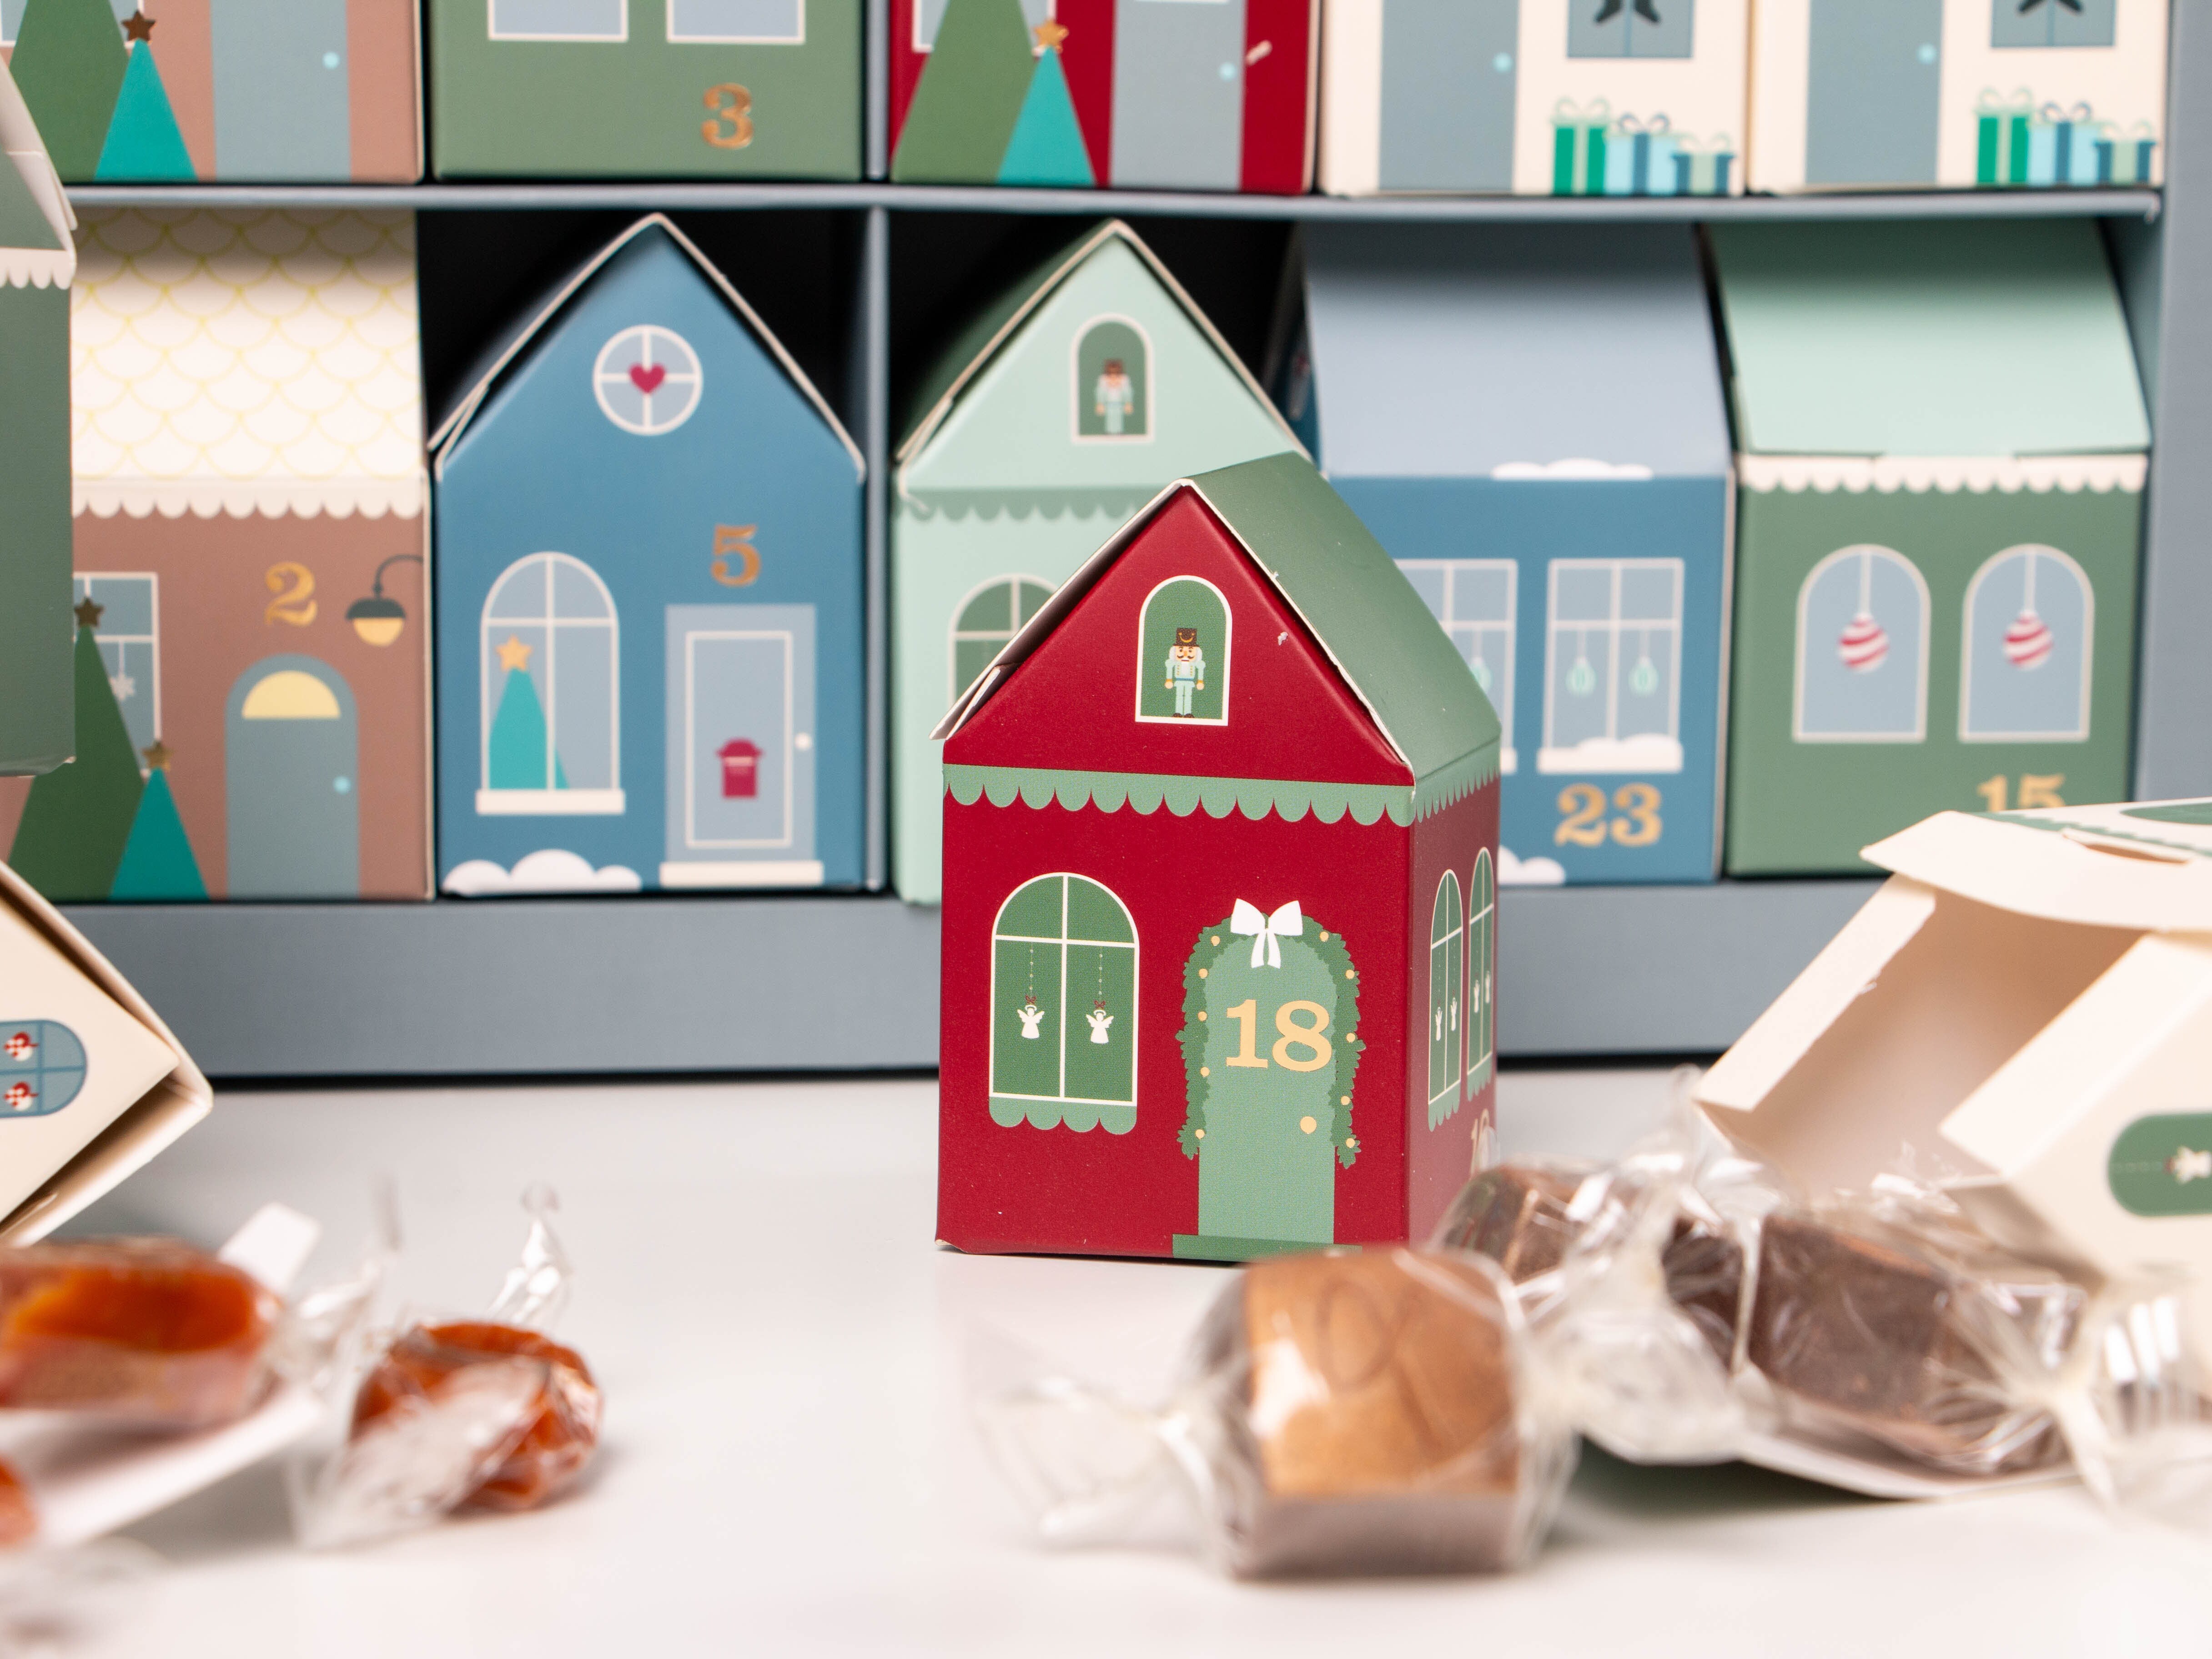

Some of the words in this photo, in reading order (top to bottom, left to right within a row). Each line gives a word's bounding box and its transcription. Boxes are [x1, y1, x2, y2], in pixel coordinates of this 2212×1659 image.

[701, 83, 754, 149] 3
[710, 524, 761, 587] 5
[265, 562, 317, 626] 2
[1555, 784, 1661, 846] 23
[1226, 999, 1332, 1072] 18
